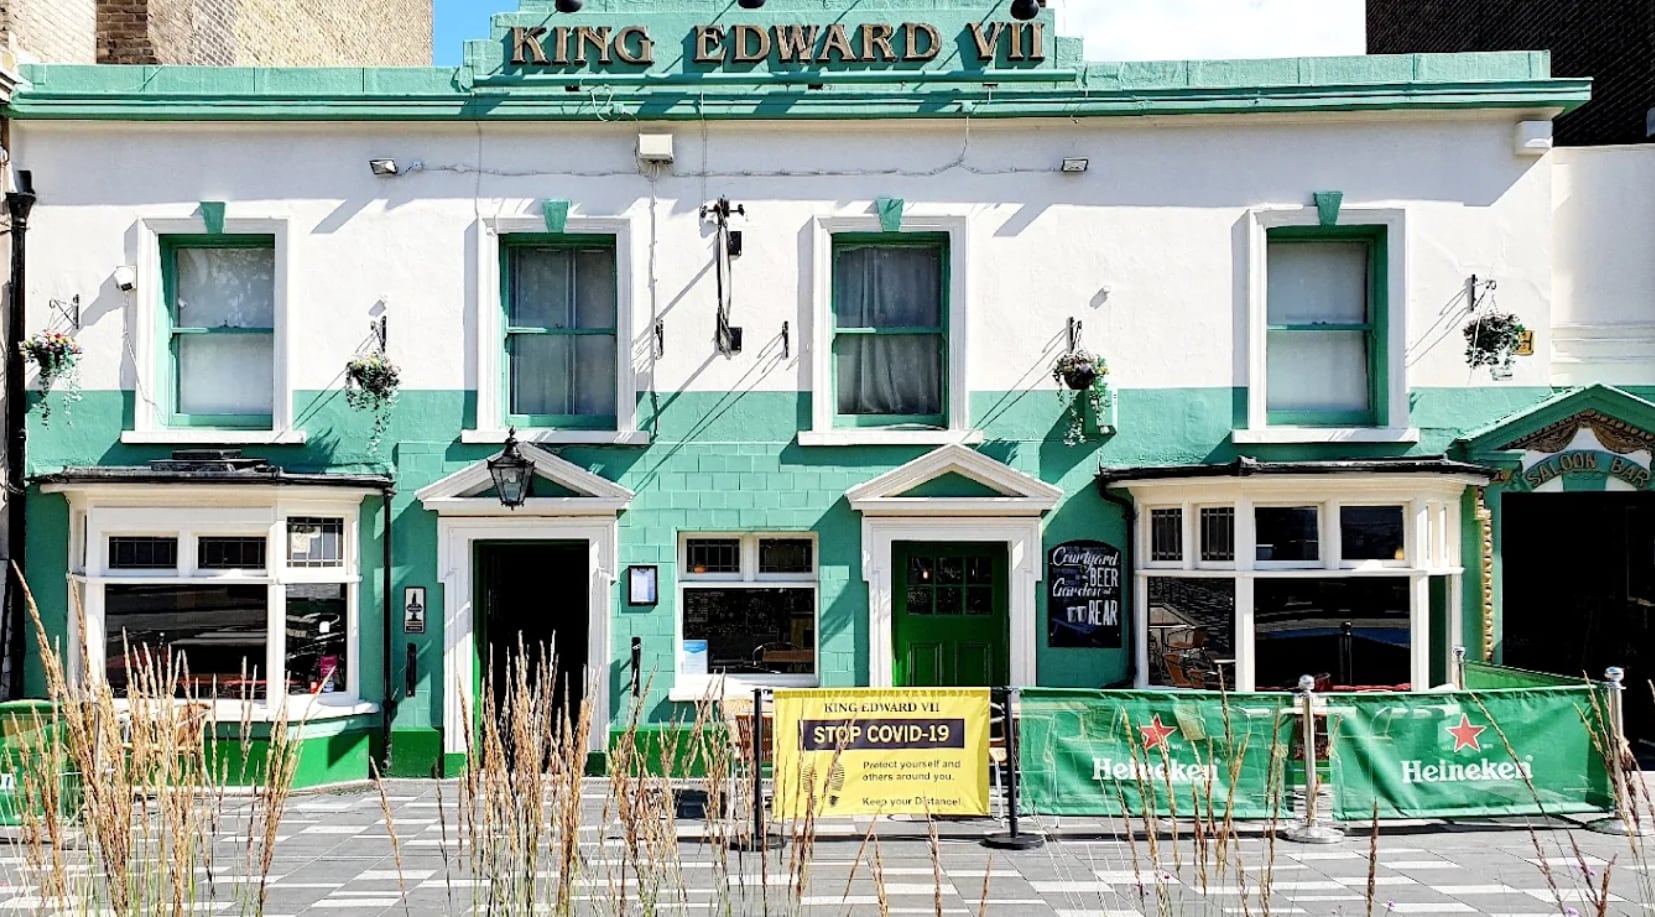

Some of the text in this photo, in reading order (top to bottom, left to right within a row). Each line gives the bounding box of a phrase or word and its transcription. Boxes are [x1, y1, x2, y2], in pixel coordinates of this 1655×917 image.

[510, 21, 1046, 65] KING EDWARD VII
[1525, 451, 1651, 488] SALOON BAR
[1052, 577, 1101, 598] Garden
[1089, 567, 1119, 588] BEER
[1088, 600, 1118, 626] REAR
[824, 701, 940, 713] KING EDWARD VII
[813, 724, 950, 745] STOP COVID-19
[863, 760, 961, 770] Protect yourself and
[1401, 758, 1534, 784] Heineken
[862, 773, 893, 782] others
[896, 772, 930, 781] around
[862, 797, 888, 807] Keep
[890, 799, 912, 807] your
